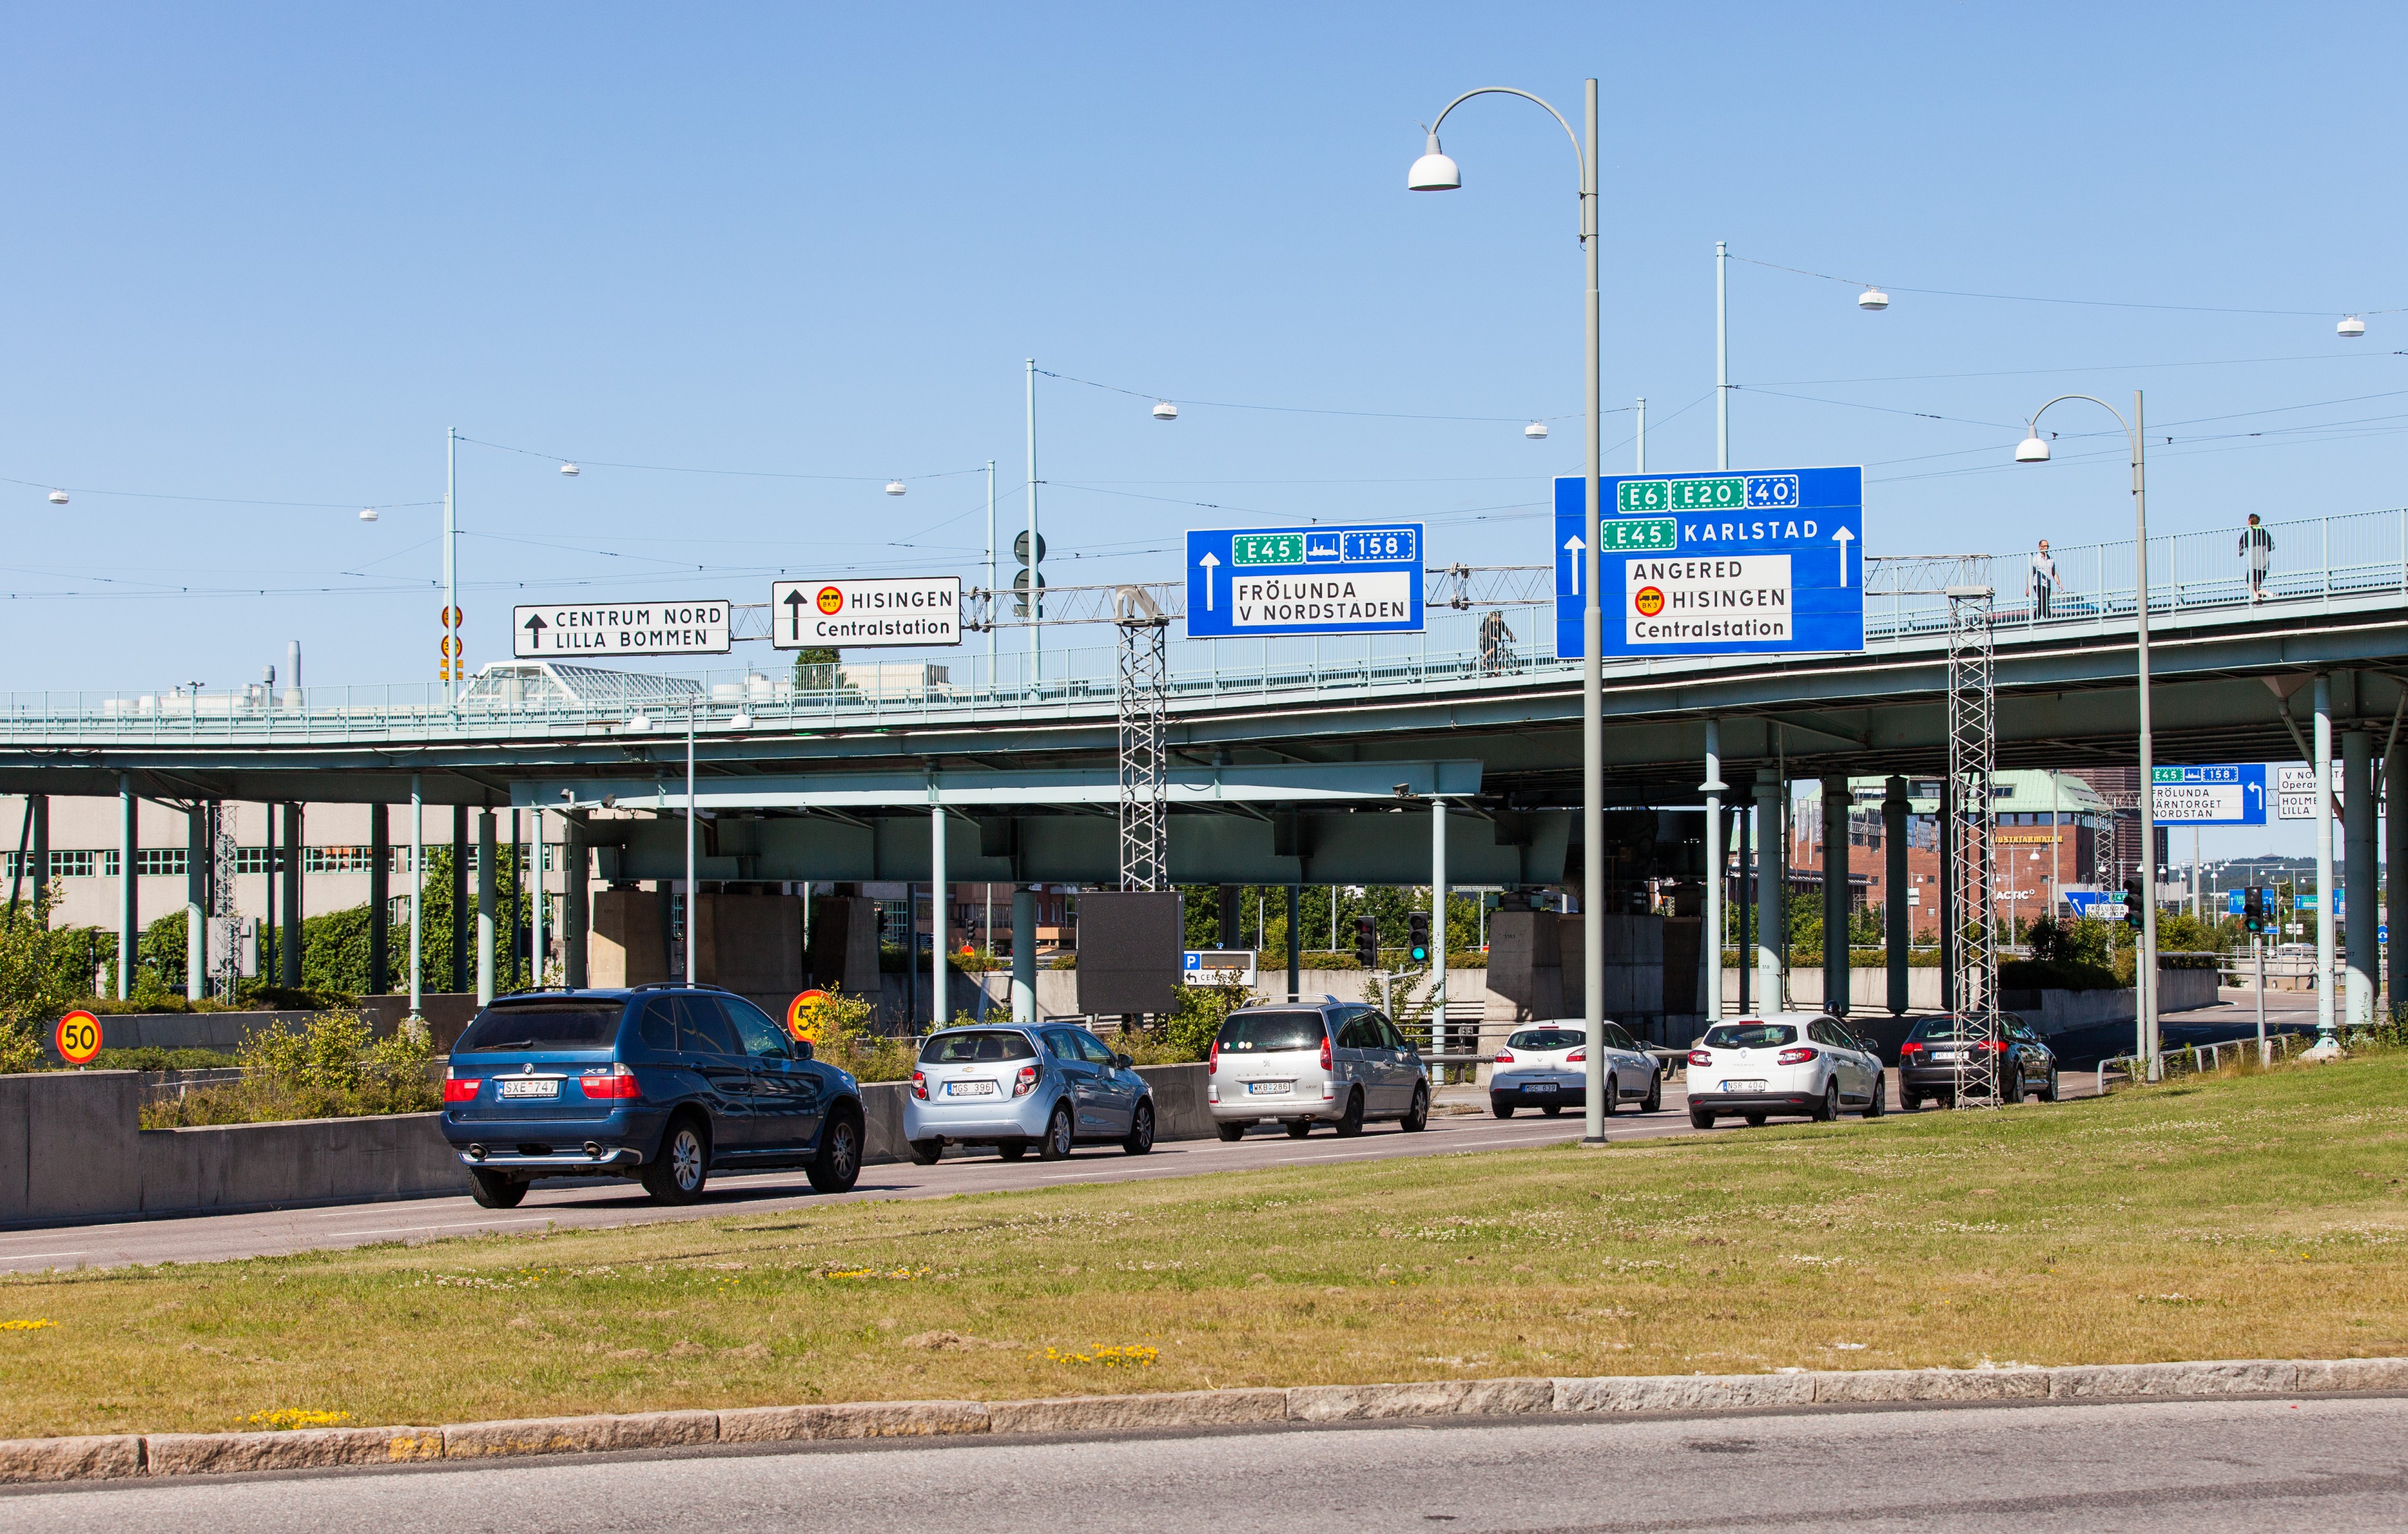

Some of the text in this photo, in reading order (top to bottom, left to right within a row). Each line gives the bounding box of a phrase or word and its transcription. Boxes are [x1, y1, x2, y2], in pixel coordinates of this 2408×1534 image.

[1630, 483, 1789, 506] E6 E20 40
[1617, 520, 1817, 544] E45 KARLSTAD
[1247, 537, 1398, 558] E45 158
[1633, 561, 1742, 580] ANGERED
[852, 591, 952, 609] HISINGEN
[1239, 580, 1356, 601] FRÖLUNDA
[1673, 589, 1784, 608] HISINGEN
[556, 607, 721, 627] CENTRUM NORD
[1239, 601, 1404, 621] V NORDSTADEN
[816, 619, 949, 637] Centralstation
[1635, 619, 1783, 638] Centralstation
[556, 629, 706, 649] LILLA BOMMEN
[2155, 770, 2230, 779] E45 158
[65, 1024, 95, 1050] 50
[506, 1081, 555, 1093] SXE 747
[975, 1083, 990, 1092] 396
